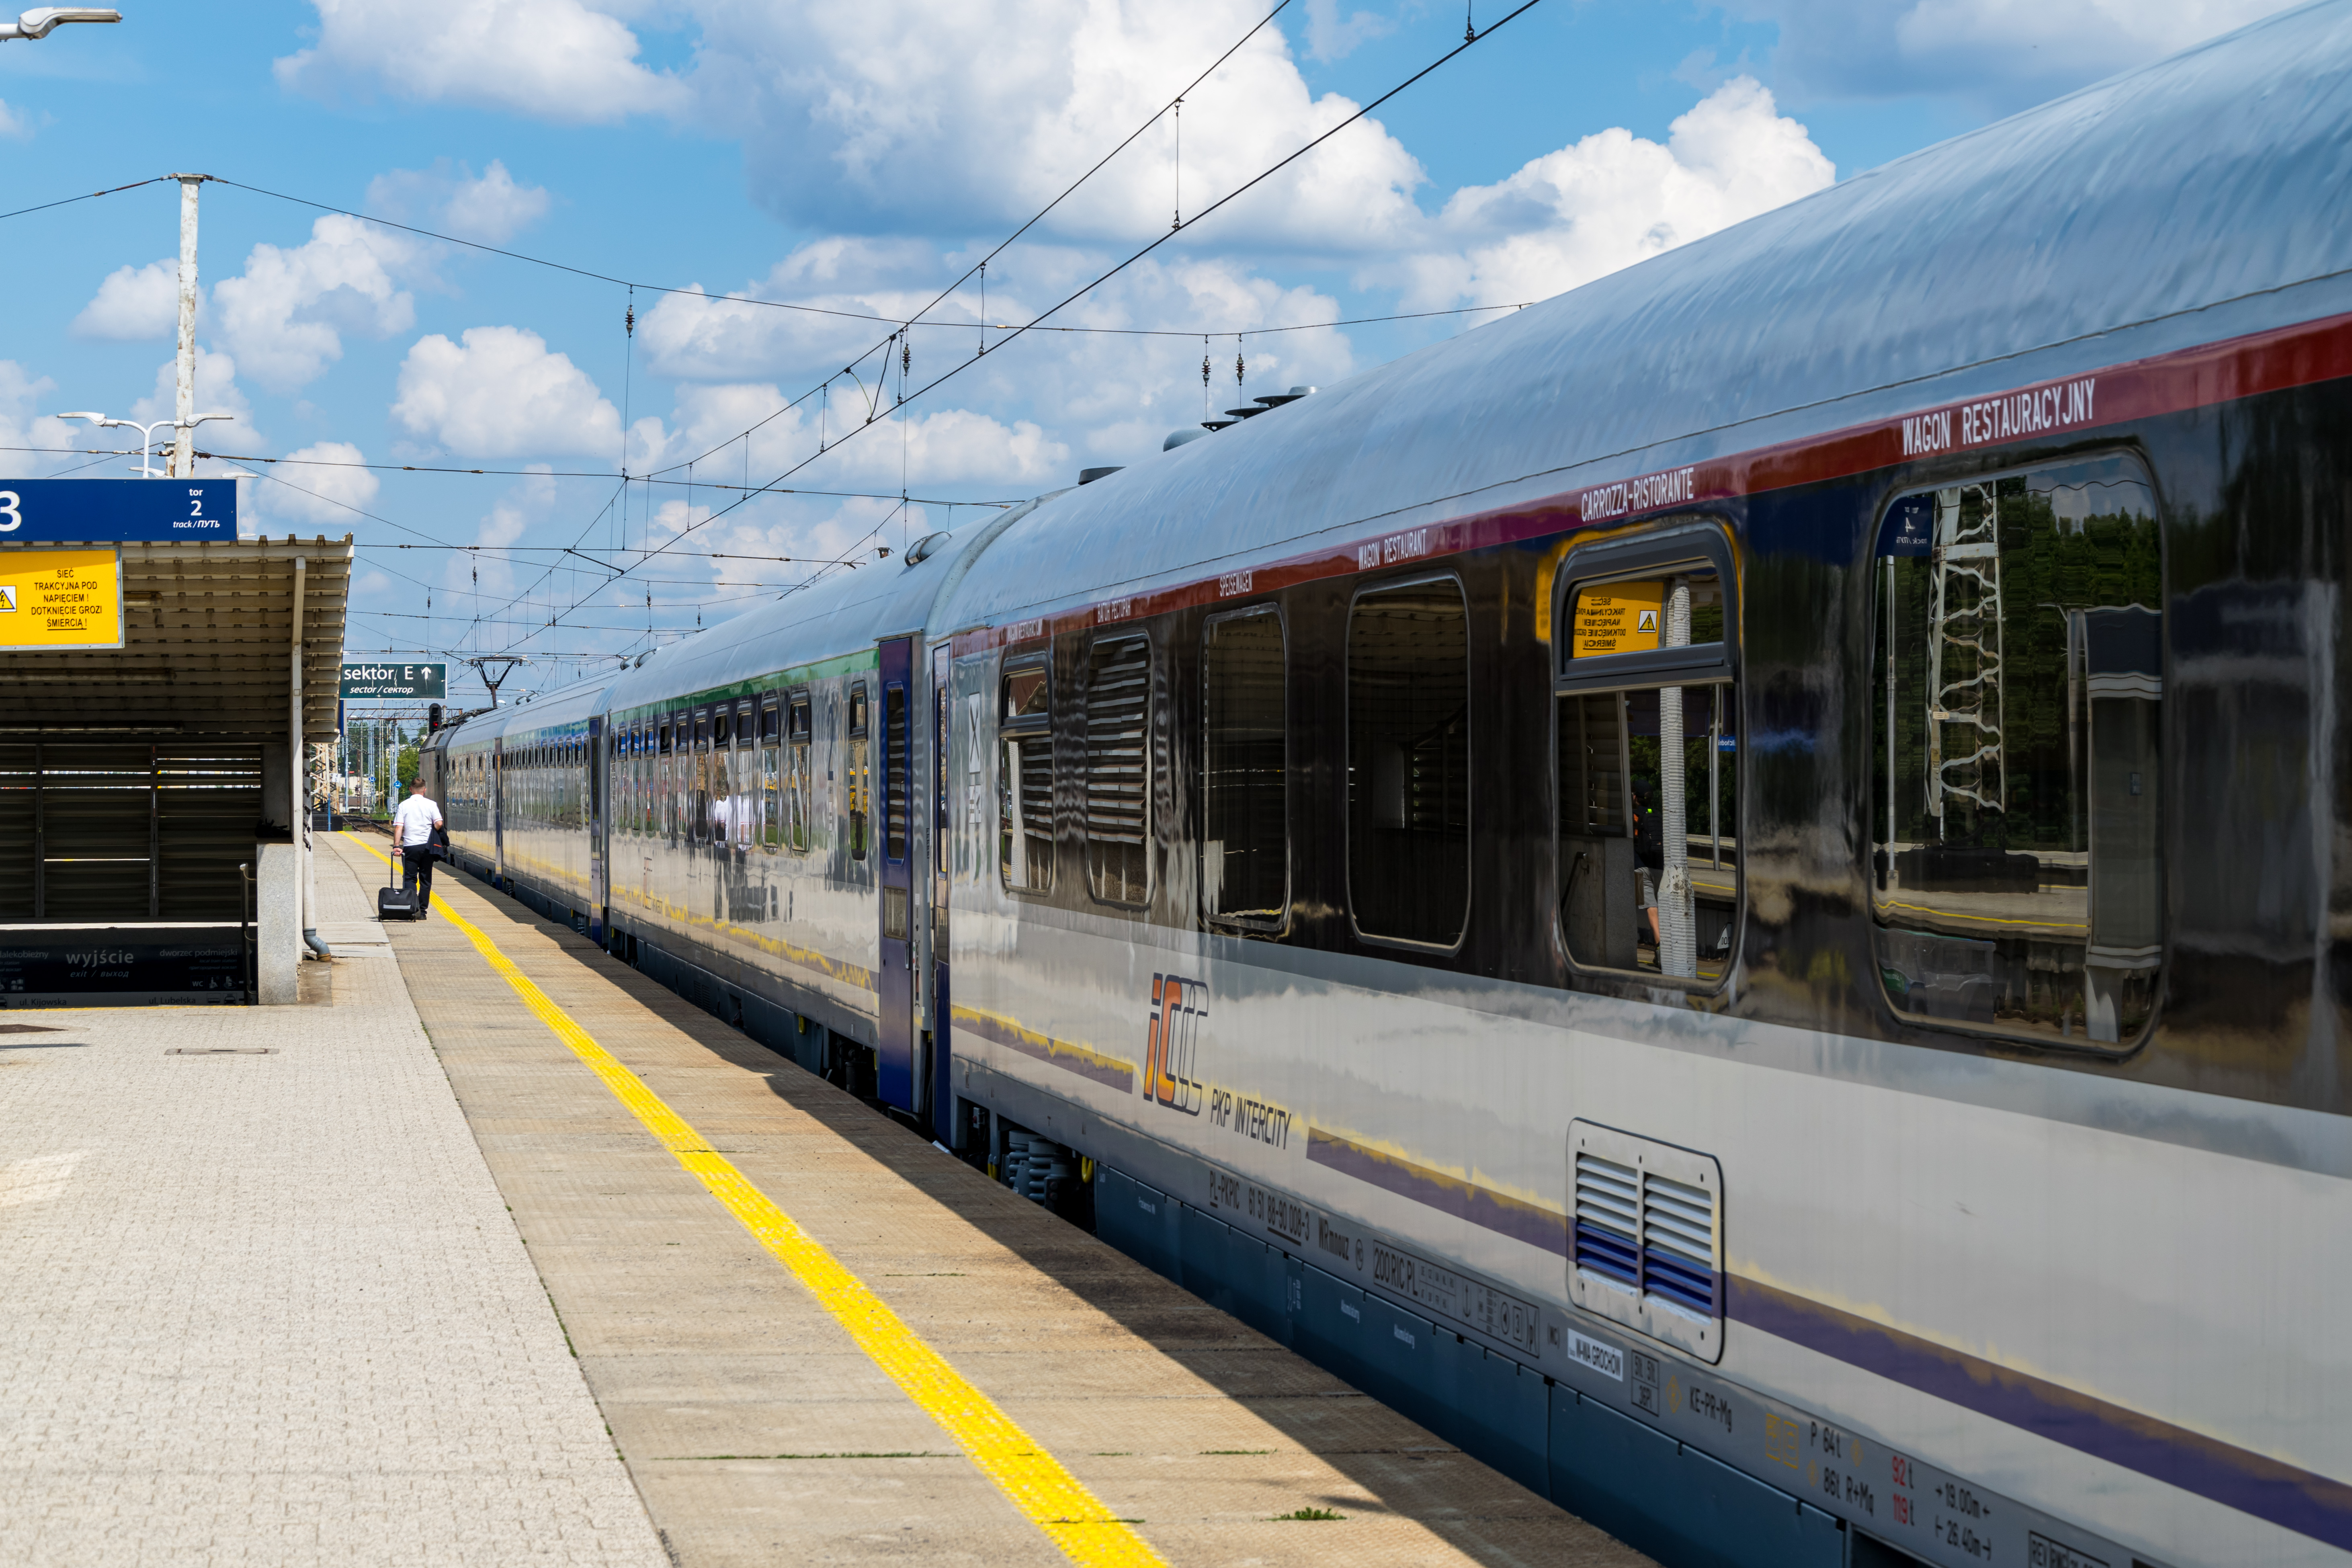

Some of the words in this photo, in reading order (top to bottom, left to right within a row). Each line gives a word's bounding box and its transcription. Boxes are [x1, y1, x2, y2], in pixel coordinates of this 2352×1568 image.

[1903, 410, 1950, 456] WAGON
[1963, 378, 2095, 445] RESTAURACYJNY
[1582, 467, 1694, 522] CARROZZA-RISTORANTE
[0, 491, 21, 531] 3
[191, 500, 202, 516] 2
[1358, 541, 1380, 571] WAGON
[1384, 529, 1426, 565] RESTAURANT
[34, 582, 80, 590] TRAKCYJNA
[82, 581, 97, 589] POD
[57, 568, 74, 578] SIEĆ
[1219, 570, 1252, 597] SPEISEWAGEN
[31, 606, 76, 617] DOTKNIĘCIE
[79, 606, 102, 614] GROZI
[43, 594, 84, 604] NAPIĘCIEM
[47, 617, 83, 629] ŚMIERCIĄ
[344, 665, 394, 680] sektor
[405, 666, 414, 680] E
[66, 949, 134, 967] wyjście
[195, 949, 238, 957] podmiejski
[31, 998, 67, 1007] Kijowska
[1211, 1088, 1231, 1127] PKP
[1234, 1096, 1291, 1150] INTERCITY
[1210, 1170, 1240, 1210] PL-PKPIC
[1249, 1187, 1255, 1217] 61
[1258, 1190, 1264, 1221] 51
[1374, 1248, 1390, 1283] 200
[1391, 1253, 1405, 1289] RIC
[1407, 1261, 1418, 1296] PL
[1810, 1421, 1817, 1447] P
[1892, 1455, 1906, 1486] 92
[1893, 1493, 1908, 1525] 119
